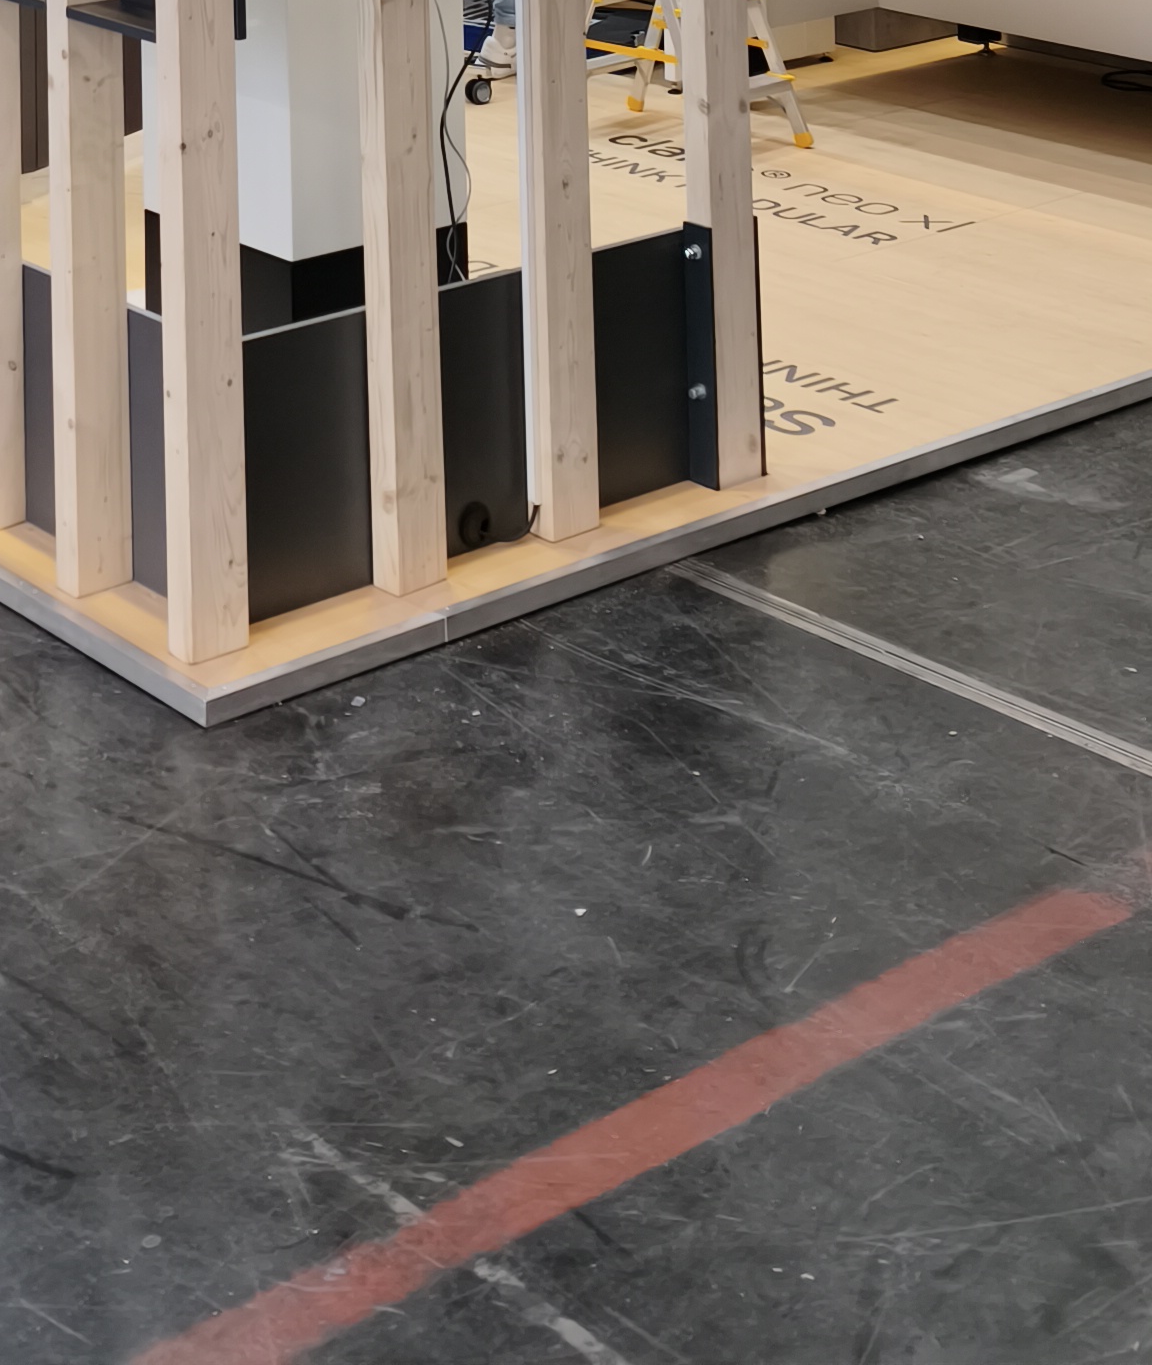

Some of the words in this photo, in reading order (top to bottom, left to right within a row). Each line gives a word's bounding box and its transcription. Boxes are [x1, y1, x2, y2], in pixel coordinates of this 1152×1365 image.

[589, 149, 685, 183] HINK
[752, 198, 899, 246] DULAR
[782, 182, 900, 216] neo
